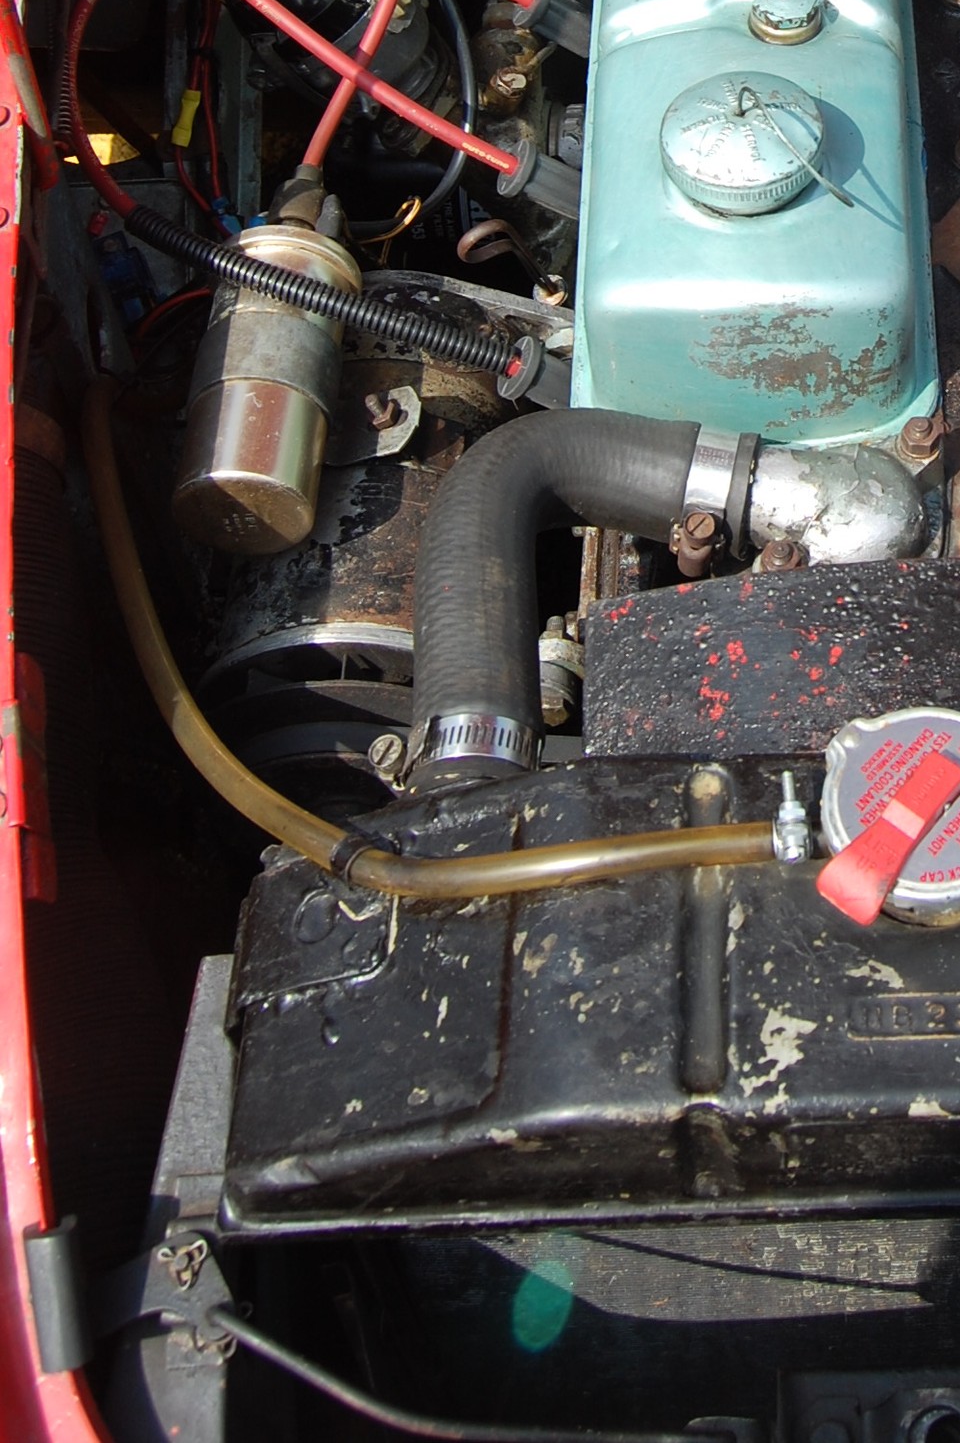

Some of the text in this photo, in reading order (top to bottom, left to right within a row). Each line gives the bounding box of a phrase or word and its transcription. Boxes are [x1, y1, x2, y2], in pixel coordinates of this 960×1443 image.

[461, 142, 510, 169] auto-tune
[932, 731, 952, 752] TEST
[855, 727, 936, 813] CHANGING COOLANT
[860, 745, 887, 774] MEXICO
[866, 742, 904, 781] ASSEMBLED
[859, 798, 888, 828] WHEN
[927, 835, 948, 857] HOT
[919, 871, 945, 883] CAP
